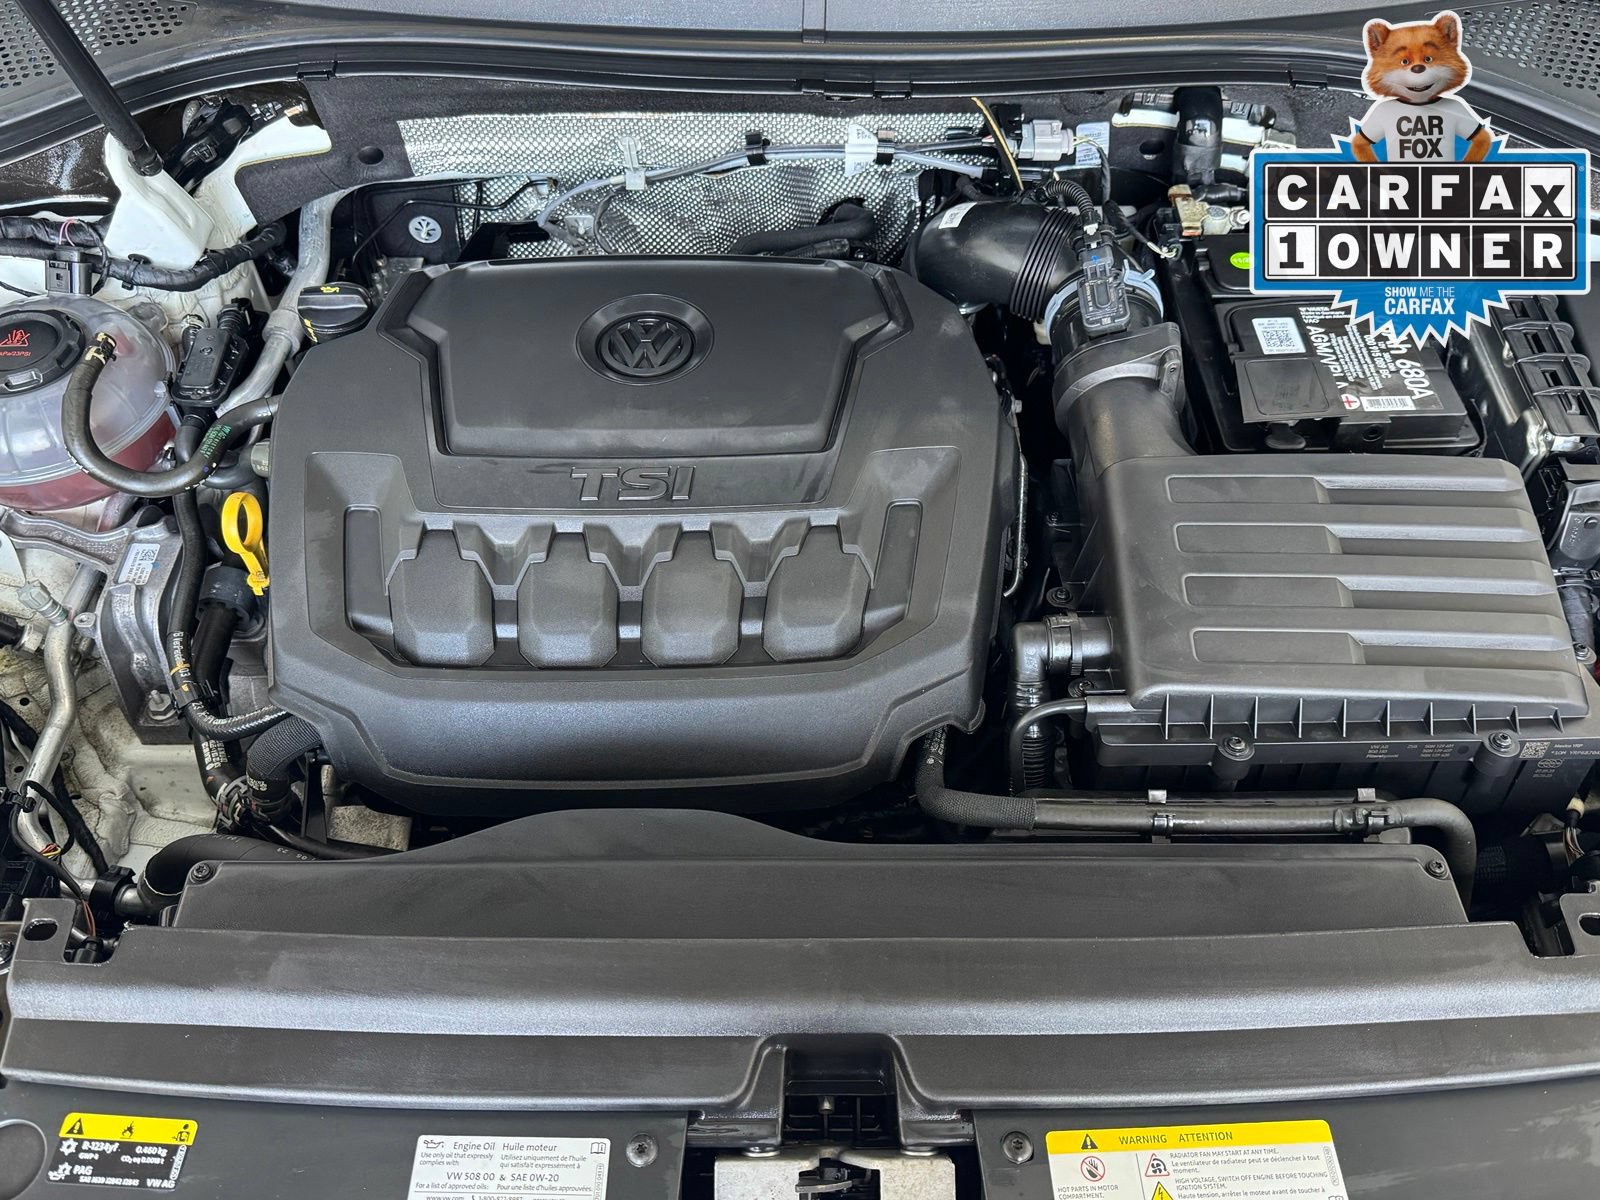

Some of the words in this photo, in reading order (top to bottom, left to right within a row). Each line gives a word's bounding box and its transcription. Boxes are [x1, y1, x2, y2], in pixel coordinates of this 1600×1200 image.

[1395, 358, 1435, 400] 680A
[570, 465, 697, 501] TSI
[1118, 1134, 1167, 1145] WARNING
[1179, 1131, 1233, 1143] ATTENTION
[453, 1141, 482, 1152] Engine
[483, 1142, 496, 1150] Oil
[502, 1142, 524, 1151] Huile
[1169, 1151, 1198, 1159] RADIATOR
[73, 1164, 94, 1176] PAG
[446, 1172, 463, 1180] VW
[464, 1172, 481, 1181] 508
[482, 1172, 495, 1181] 00
[510, 1173, 528, 1182] SAE
[529, 1174, 560, 1182] 0W-20
[146, 1178, 162, 1188] VW
